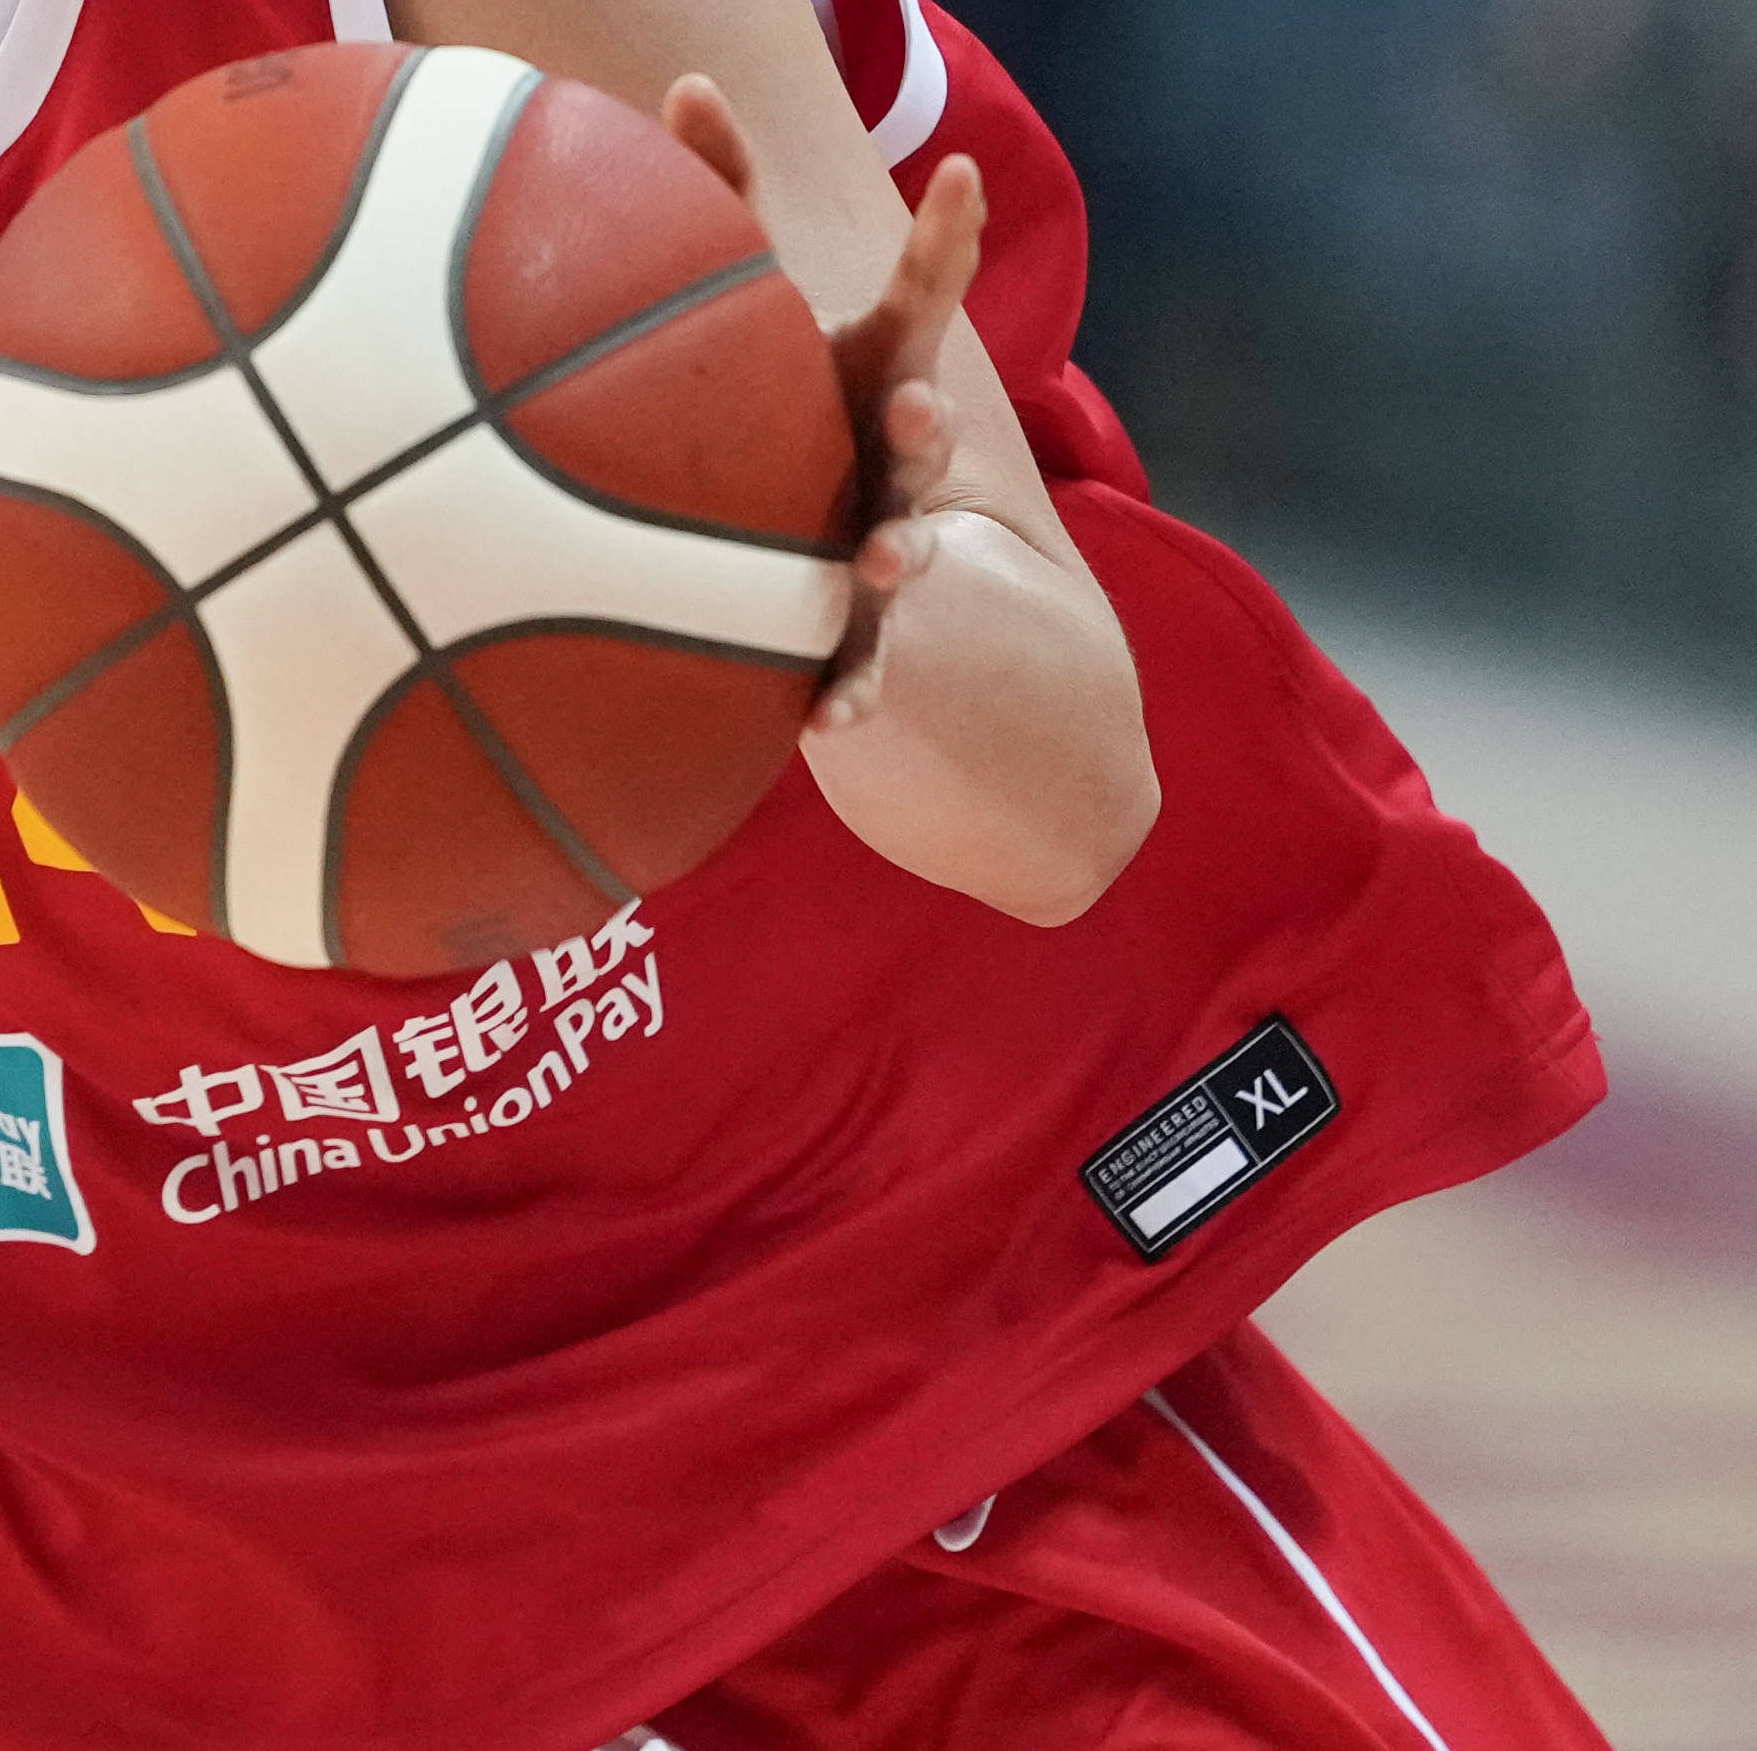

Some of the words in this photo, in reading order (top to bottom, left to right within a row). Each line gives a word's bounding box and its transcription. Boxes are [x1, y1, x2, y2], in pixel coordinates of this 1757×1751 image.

[132, 897, 655, 1137] 中国银联
[162, 1133, 361, 1224] China
[367, 951, 664, 1163] UnionPay
[1234, 1068, 1309, 1131] XL
